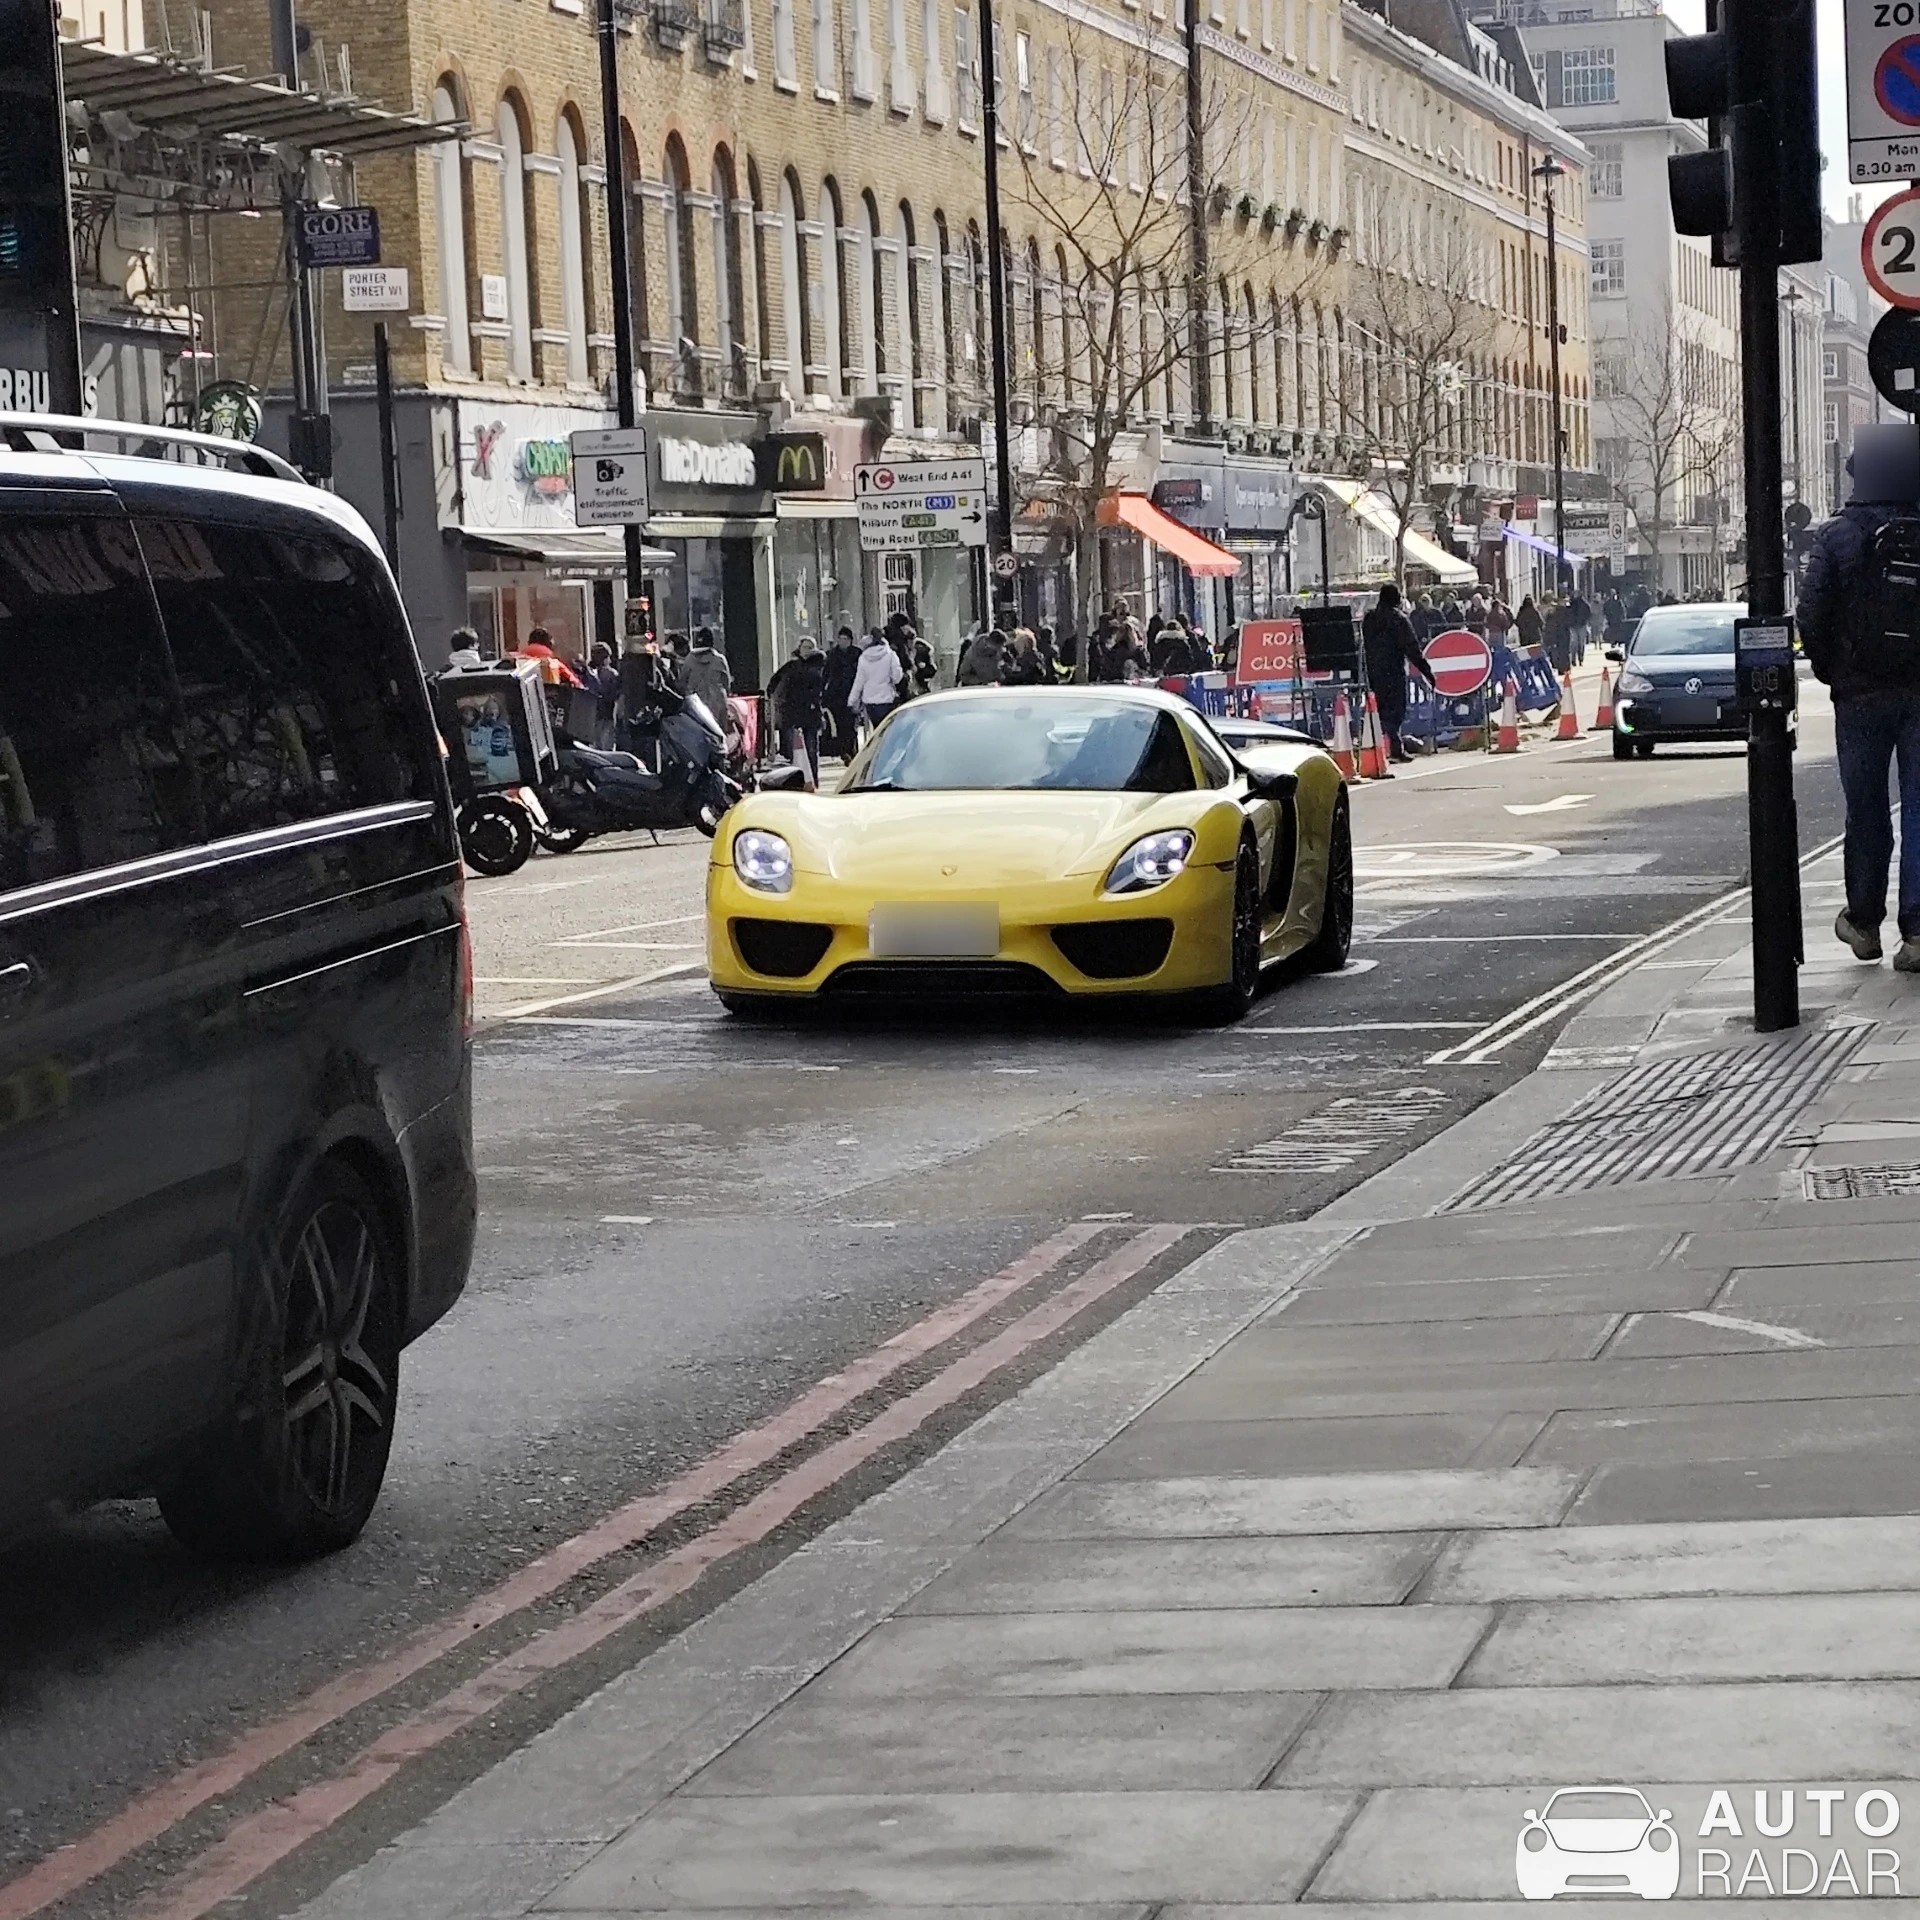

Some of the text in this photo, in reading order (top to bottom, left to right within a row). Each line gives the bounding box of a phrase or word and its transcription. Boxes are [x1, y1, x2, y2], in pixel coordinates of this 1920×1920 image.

[1873, 2, 1920, 27] ZO
[1894, 163, 1916, 173] am
[303, 213, 372, 236] GORE
[349, 273, 387, 284] PORTER
[350, 286, 385, 297] STREET
[898, 473, 923, 483] West
[928, 470, 947, 481] End
[594, 486, 630, 497] Traffic
[862, 502, 879, 511] The
[883, 500, 922, 510] NORTH
[861, 519, 899, 528] Kilburn
[863, 534, 886, 546] Ring
[889, 533, 915, 544] Road
[997, 558, 1015, 570] 20
[1262, 631, 1304, 646] ROA
[1250, 655, 1307, 670] CLOSE
